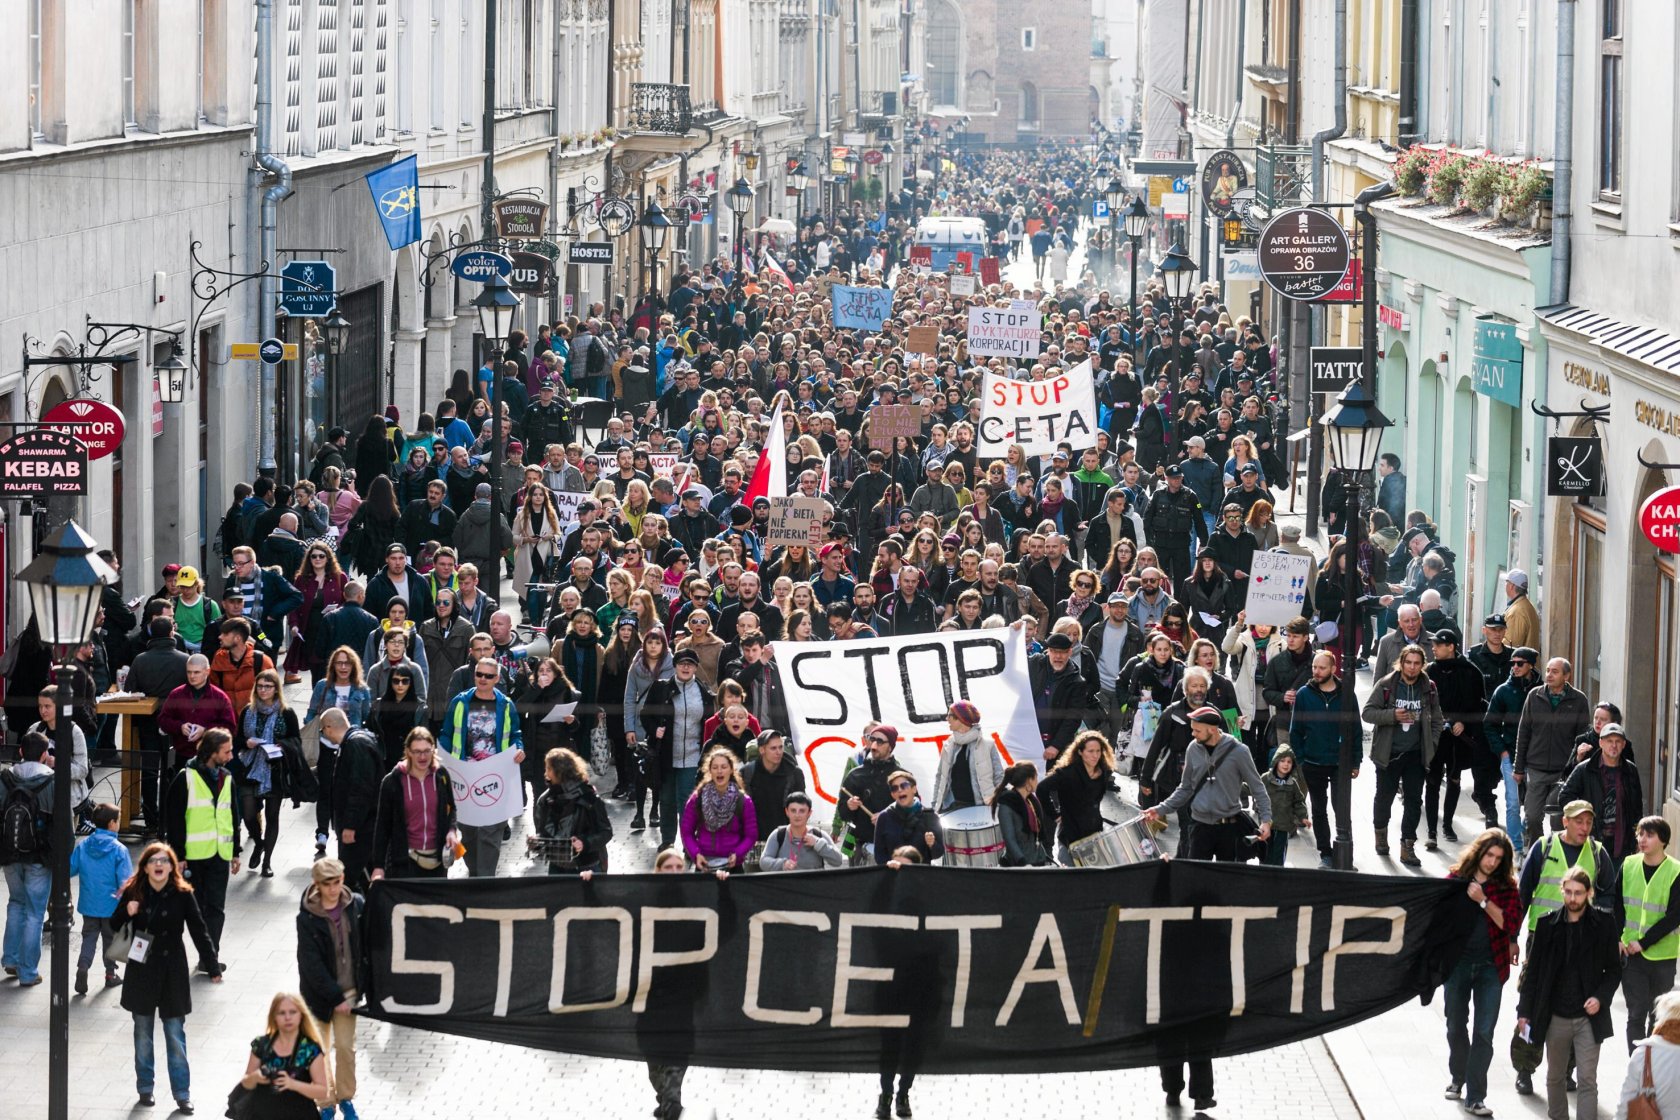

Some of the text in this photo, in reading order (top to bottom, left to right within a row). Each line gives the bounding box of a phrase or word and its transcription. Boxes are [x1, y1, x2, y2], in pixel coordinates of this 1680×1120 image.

[502, 205, 540, 216] RESTAURACJA
[1096, 206, 1106, 216] P
[508, 222, 535, 234] STODOŁA
[1270, 236, 1337, 245] ART GALLERY
[571, 248, 612, 258] HOSTEL
[911, 256, 930, 266] CETA
[1294, 256, 1314, 270] 36
[982, 312, 1028, 326] STOP
[972, 325, 1040, 340] DYKTATURZE
[970, 338, 1030, 356] KORPORACJI
[872, 406, 911, 418] CETA
[874, 418, 916, 428] TO NIE
[980, 409, 1090, 444] CETA
[0, 434, 84, 454] BEIRUT
[652, 458, 675, 468] ACTA
[5, 462, 80, 477] KEBAB
[774, 498, 794, 508] JAKO
[771, 518, 786, 528] NIE
[770, 529, 808, 540] POPIERAM
[1256, 554, 1308, 567] JESTEM TYM
[792, 636, 1006, 726] STOP
[474, 781, 499, 796] CETA
[380, 903, 1407, 1038] STOP CETA/TTIP
